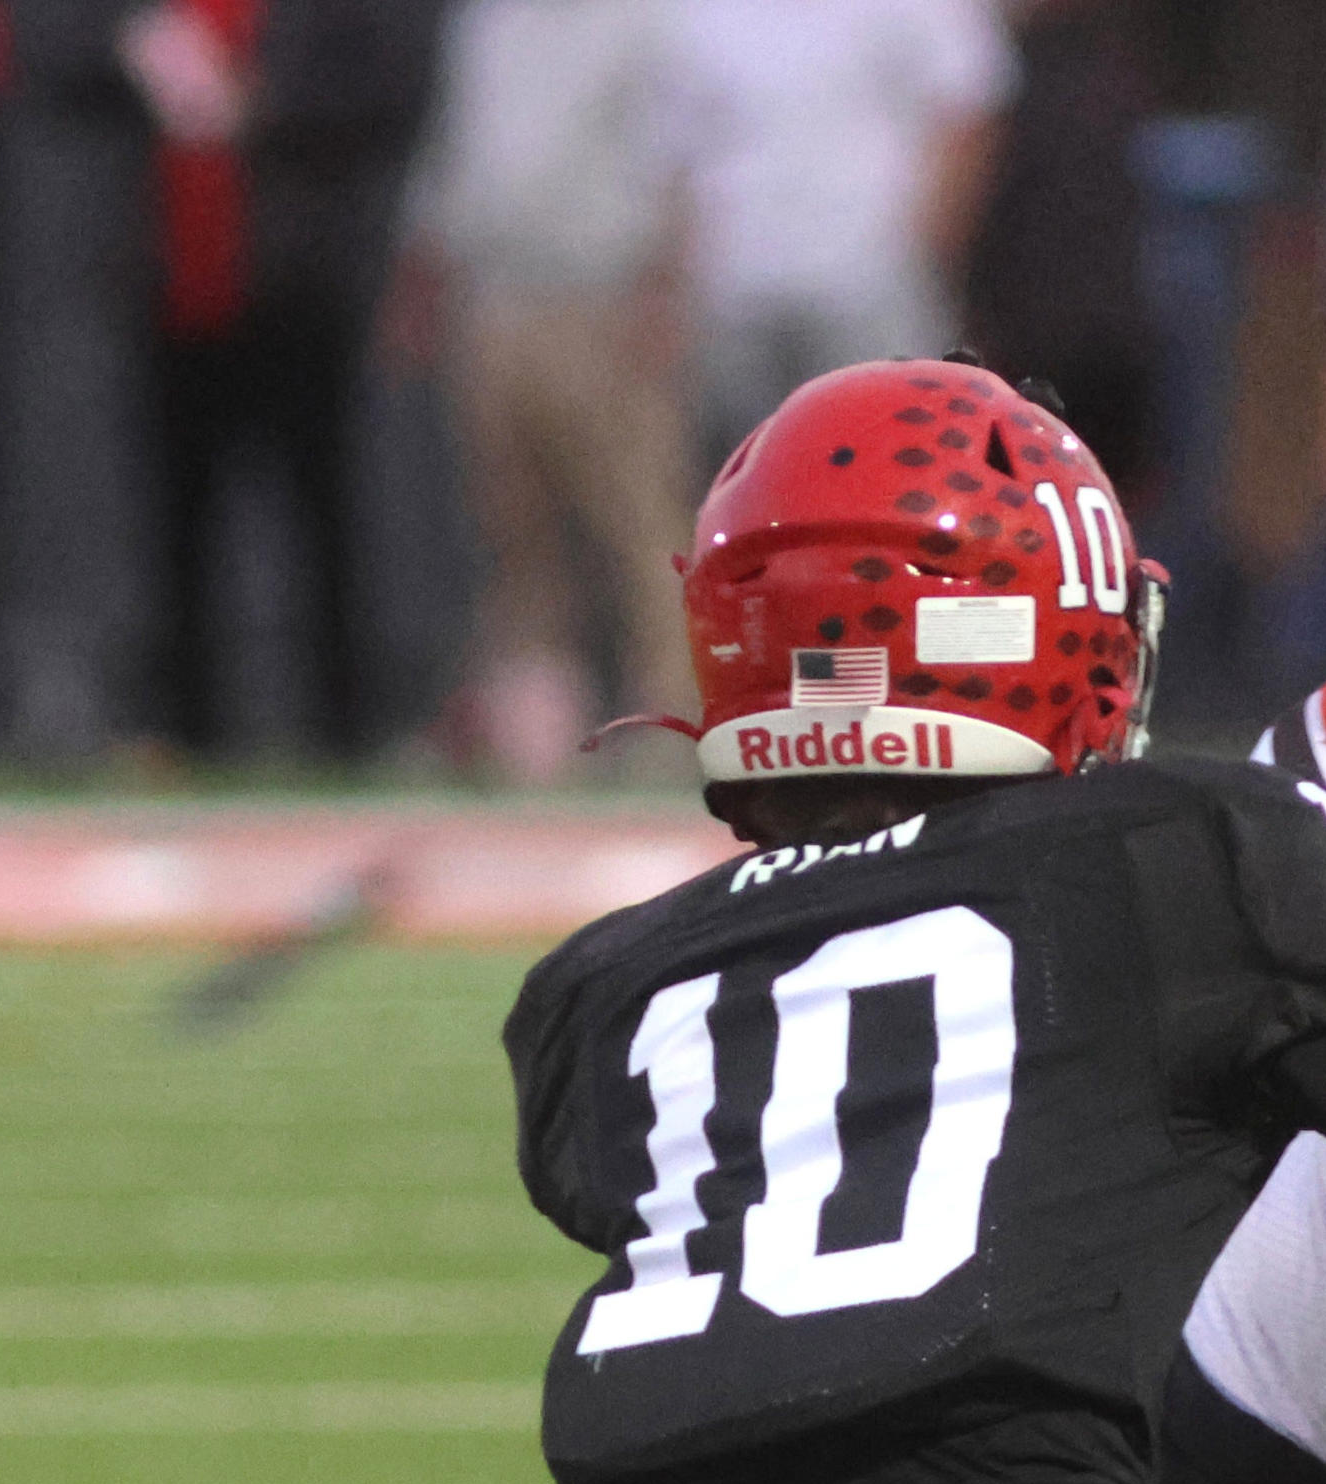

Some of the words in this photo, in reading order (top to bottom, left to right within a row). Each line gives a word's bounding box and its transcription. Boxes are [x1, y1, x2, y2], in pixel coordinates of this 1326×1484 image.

[1035, 482, 1127, 614] 10
[737, 722, 954, 771] Riddell
[575, 905, 1018, 1355] 10
